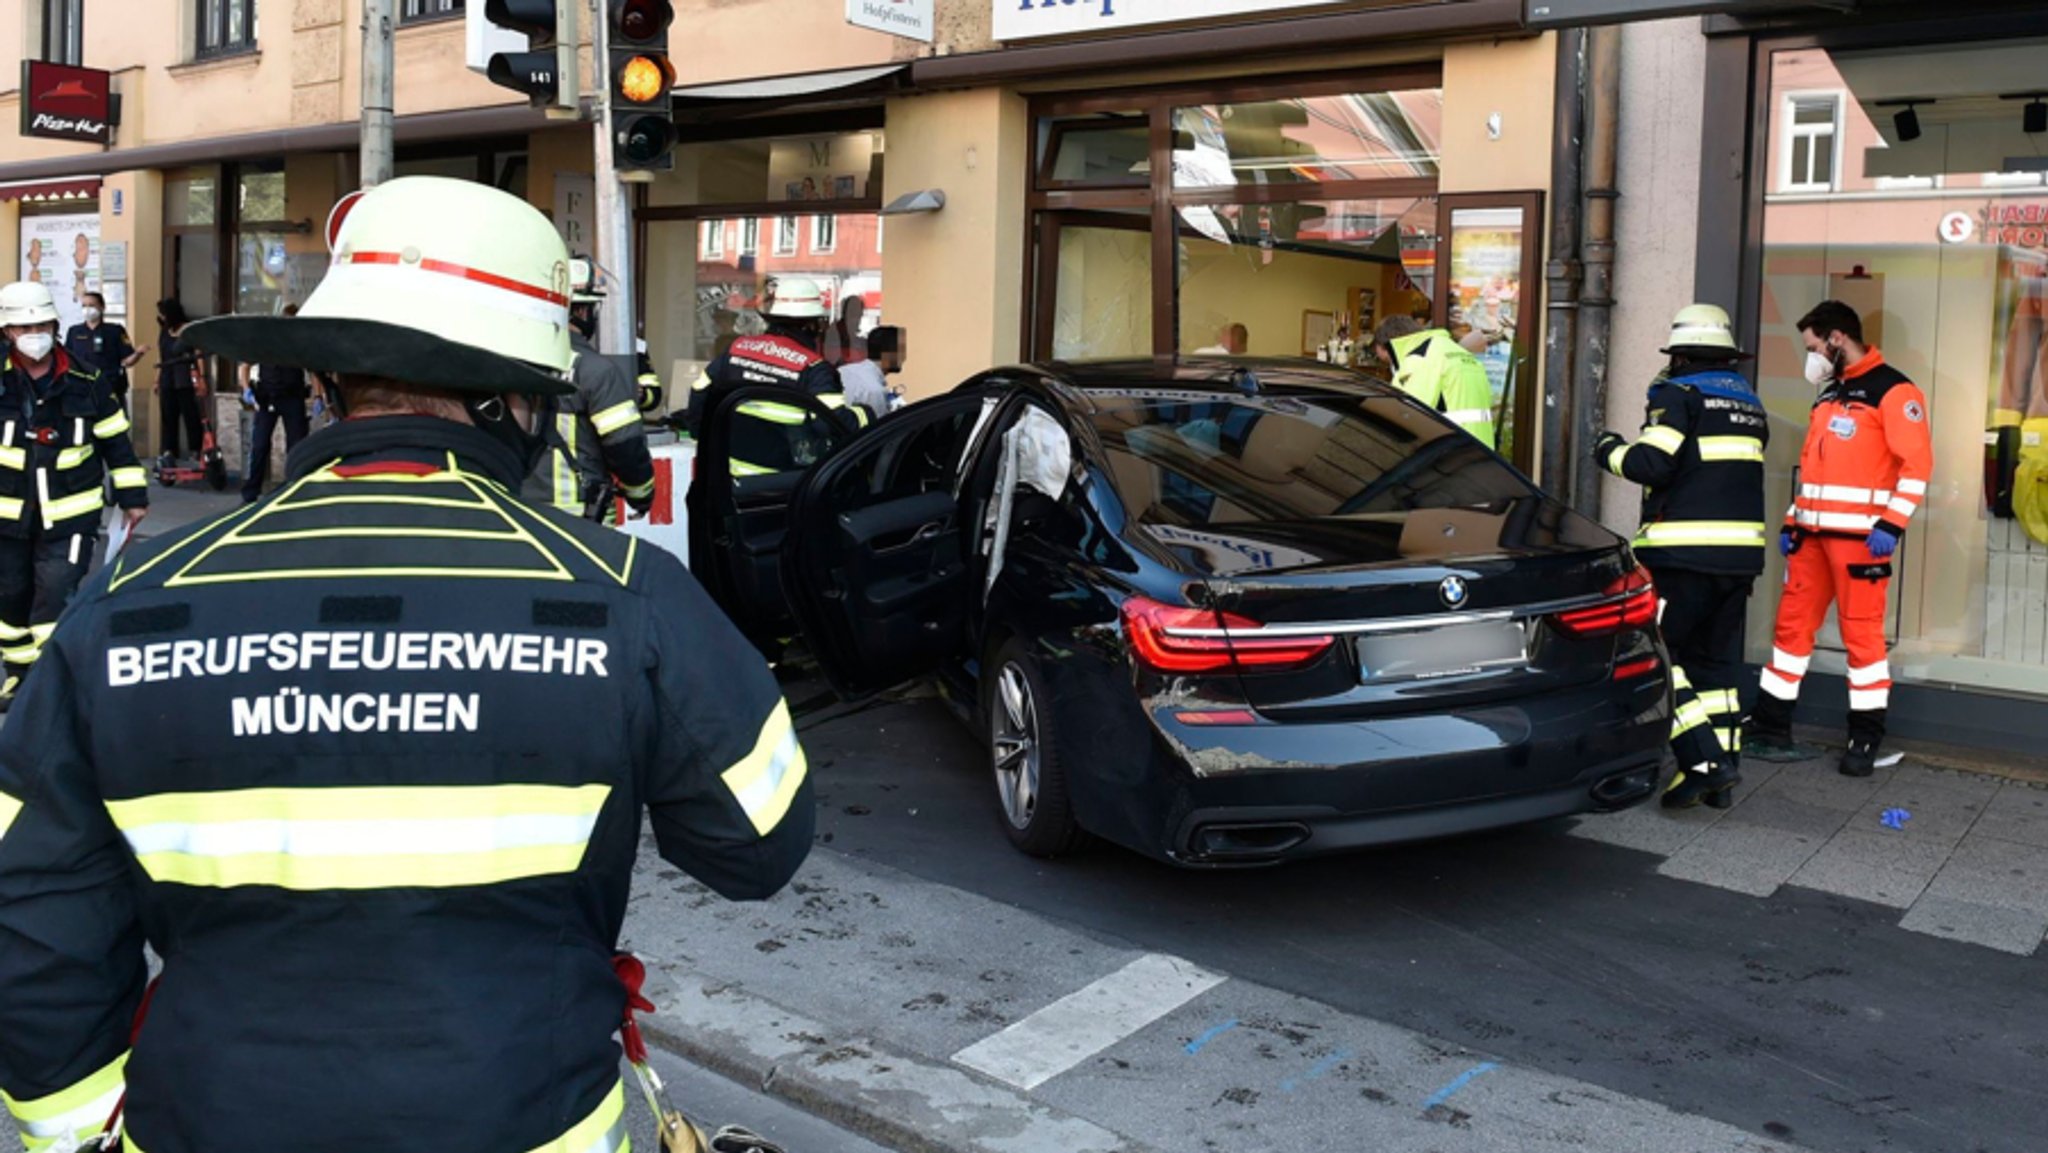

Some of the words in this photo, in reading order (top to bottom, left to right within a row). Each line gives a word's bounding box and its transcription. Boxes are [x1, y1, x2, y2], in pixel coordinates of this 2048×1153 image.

[32, 113, 74, 131] Pizza
[75, 119, 105, 134] Hut
[107, 632, 609, 686] BERUFSFEUERWEHR
[231, 688, 480, 736] MÜNCHEN
